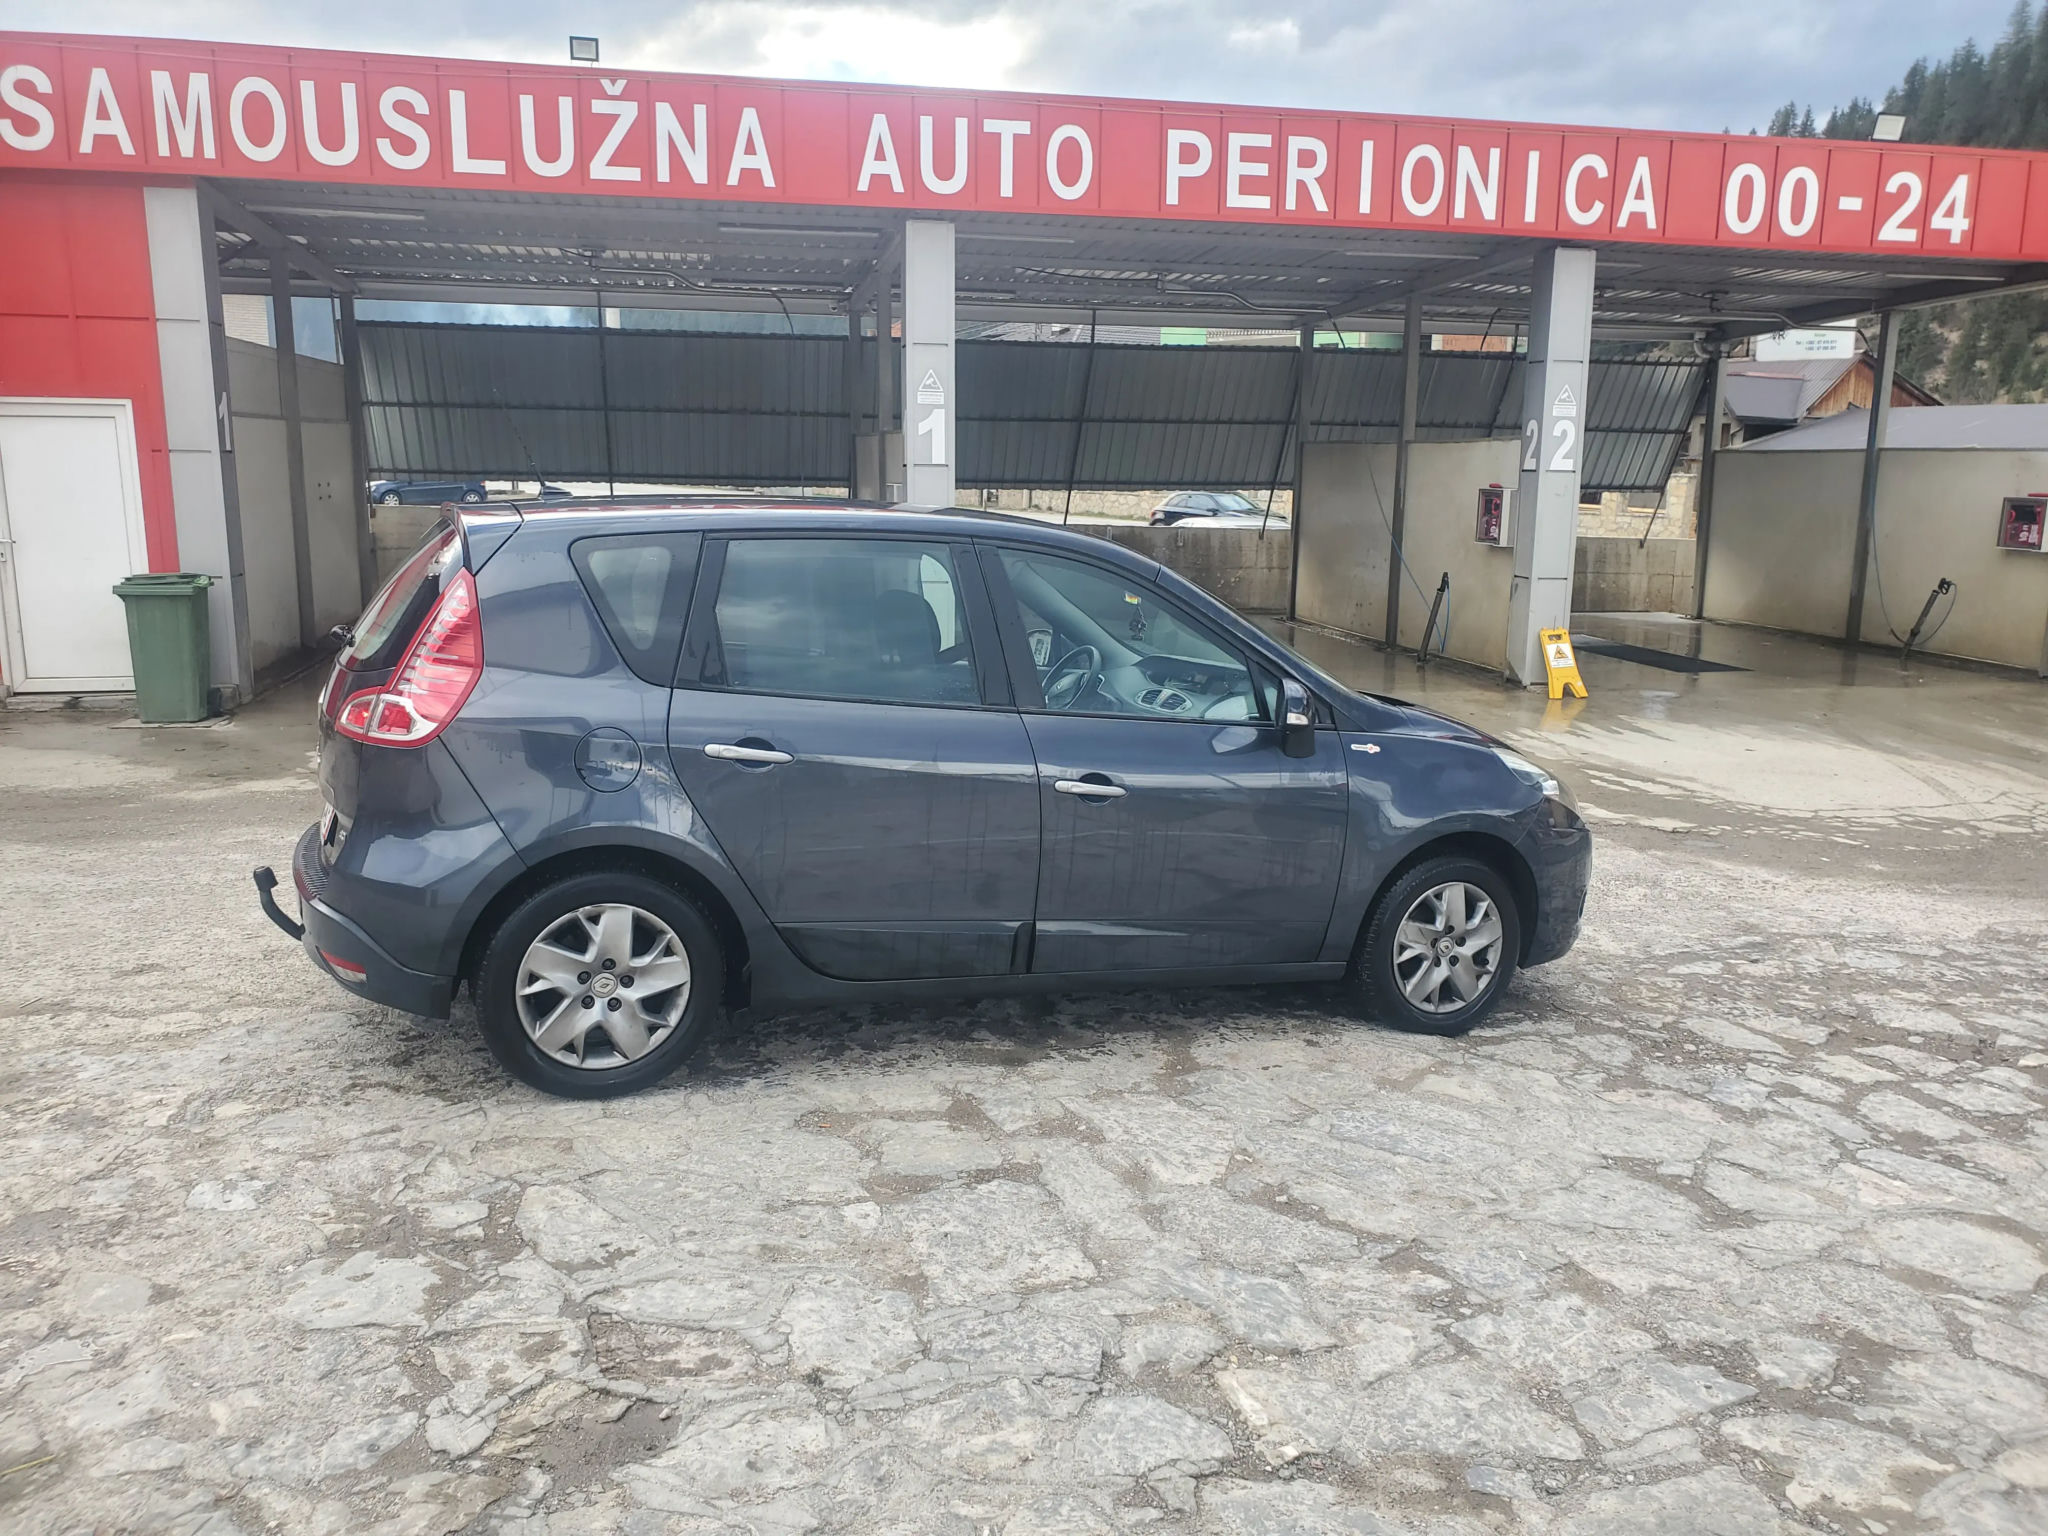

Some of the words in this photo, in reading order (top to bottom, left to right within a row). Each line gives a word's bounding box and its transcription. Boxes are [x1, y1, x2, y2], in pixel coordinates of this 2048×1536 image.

[0, 64, 776, 188] SAMOUSLUŽNA
[856, 112, 1093, 200] AUTO
[1165, 128, 1657, 230] PERIONICA
[1724, 162, 1970, 244] 00-24
[219, 392, 231, 451] 1
[918, 408, 946, 464] 1
[1524, 419, 1538, 469] 2
[1550, 419, 1575, 470] 2
